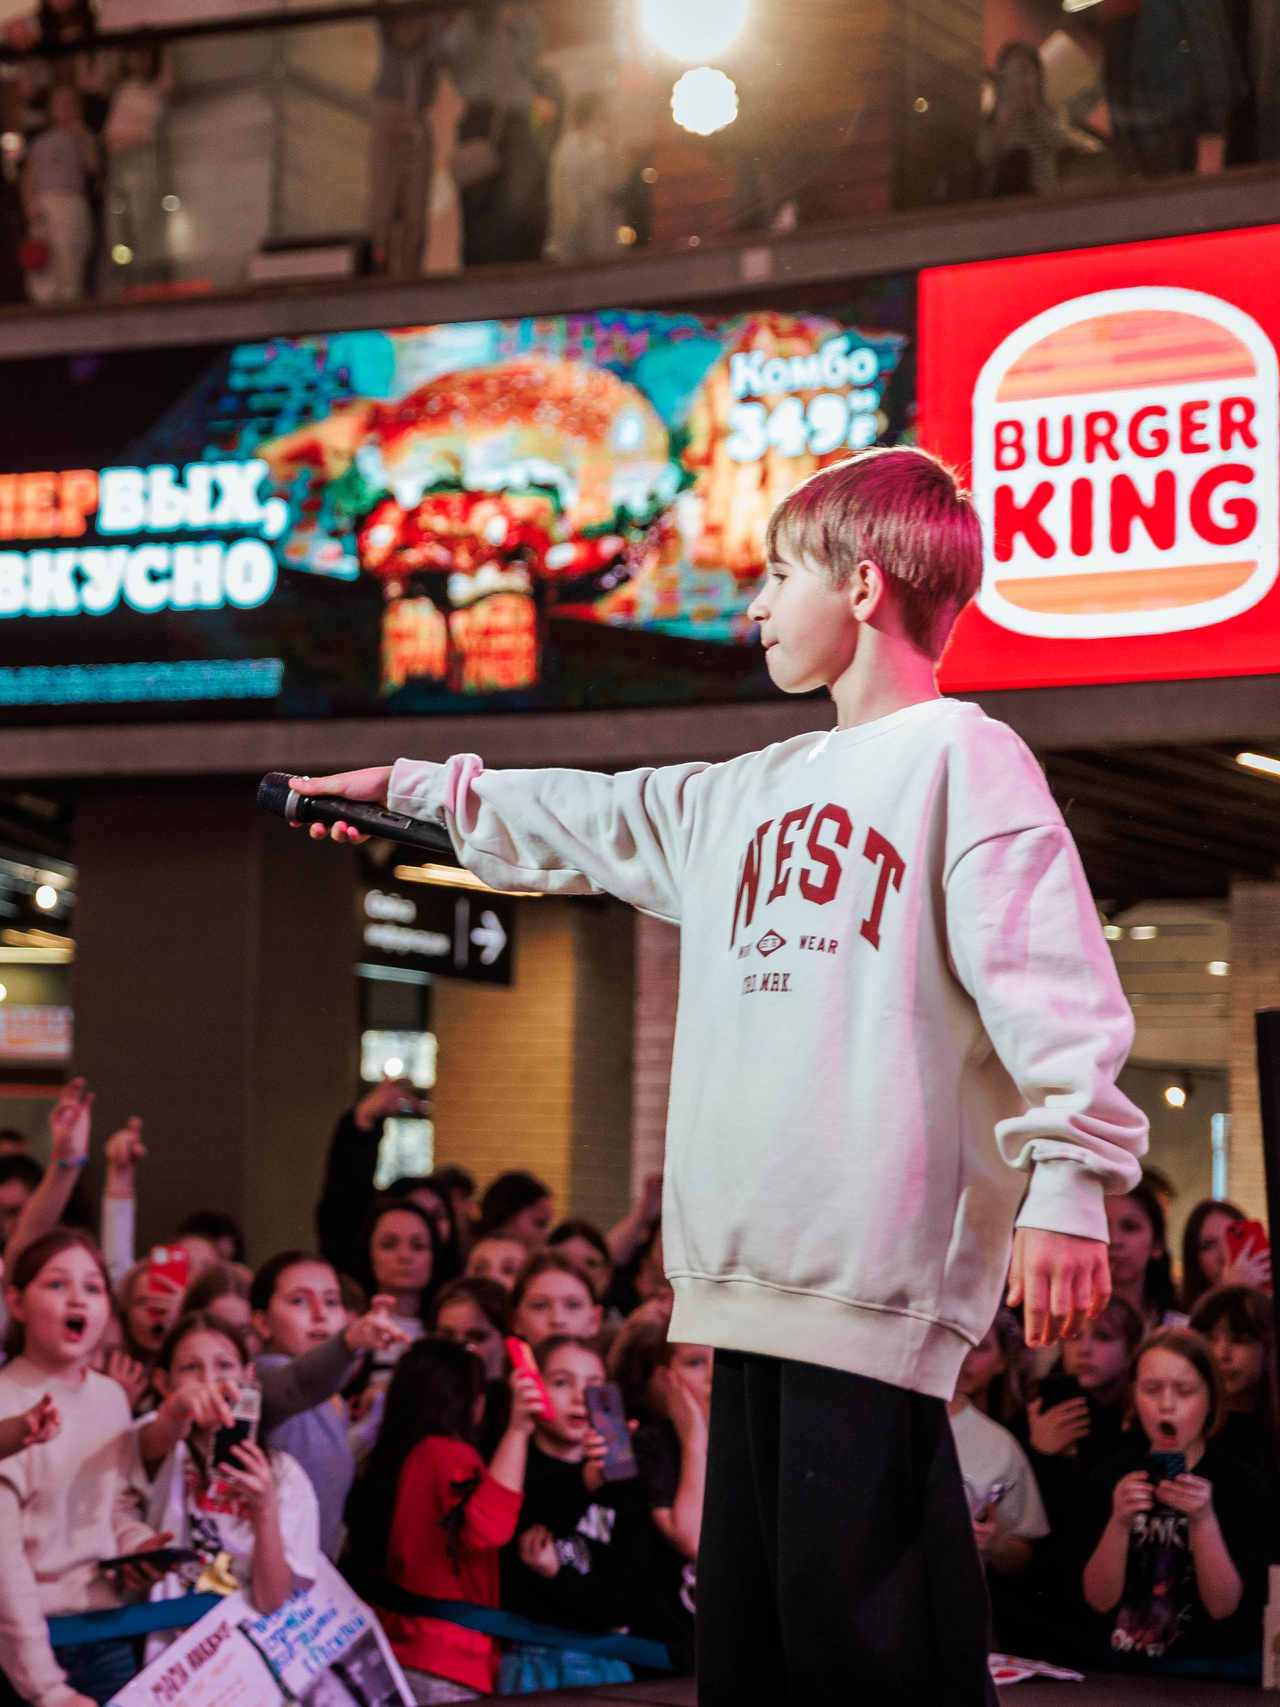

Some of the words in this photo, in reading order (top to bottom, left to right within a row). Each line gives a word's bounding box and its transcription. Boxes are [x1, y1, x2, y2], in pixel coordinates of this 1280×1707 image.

[730, 335, 880, 398] Комбо
[994, 396, 1258, 471] BURGER
[993, 463, 1258, 563] KING
[799, 935, 839, 954] WEAR
